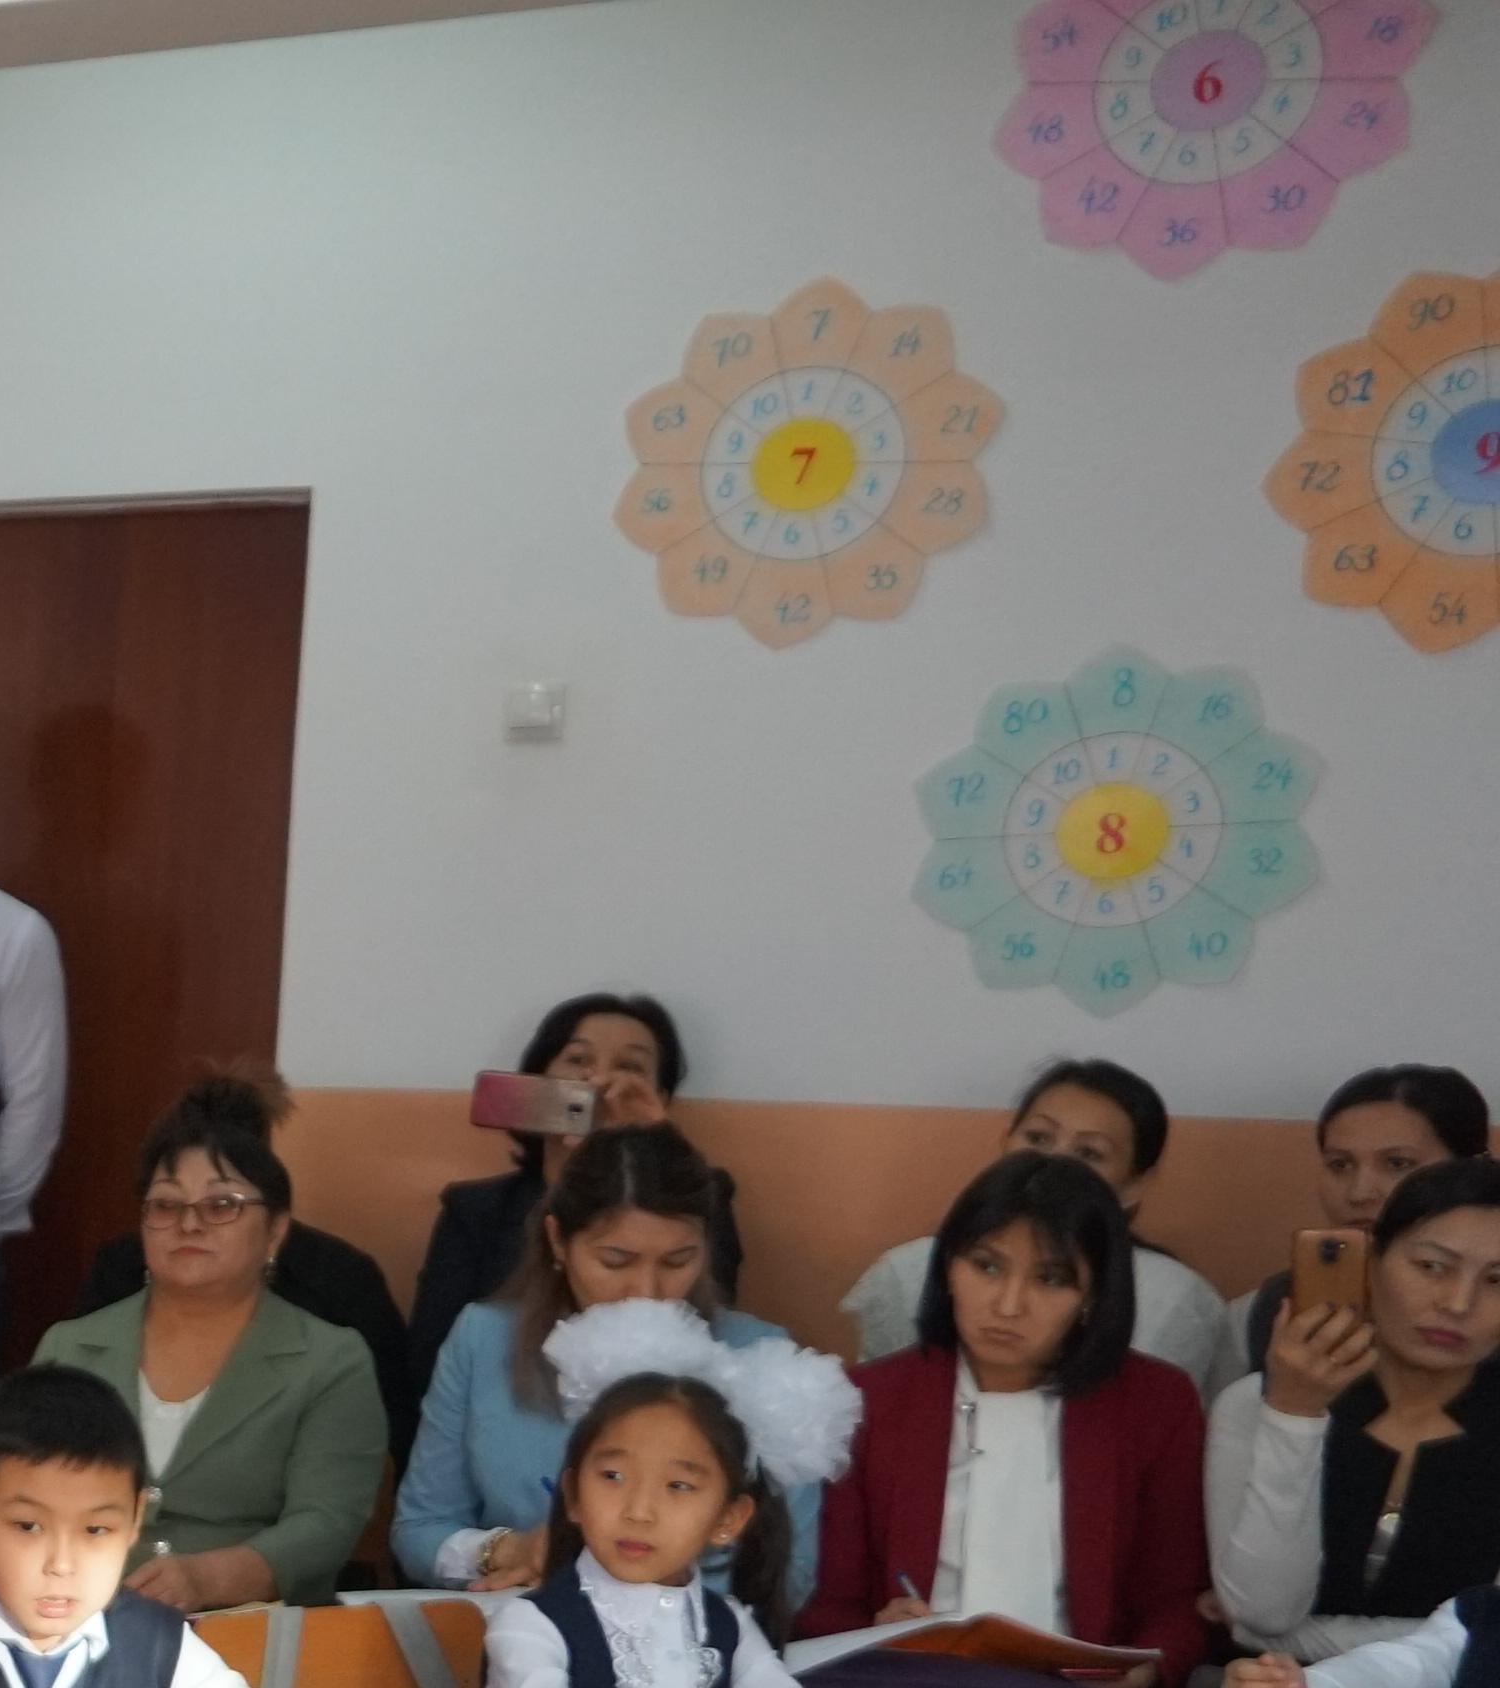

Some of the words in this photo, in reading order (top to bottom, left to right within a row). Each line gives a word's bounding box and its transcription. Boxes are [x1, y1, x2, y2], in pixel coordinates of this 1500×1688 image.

[1041, 19, 1079, 52] 54
[1366, 15, 1403, 44] 18
[1124, 47, 1144, 69] 9
[1286, 43, 1303, 67] 3
[1193, 60, 1224, 104] 6
[1109, 88, 1131, 121] 8
[1273, 89, 1291, 116] 4
[1343, 102, 1379, 130] 24
[1029, 114, 1064, 145] 48
[1138, 130, 1157, 155] 7
[1233, 128, 1252, 154] 5
[1179, 138, 1197, 166] 6
[1079, 176, 1120, 216] 42
[1265, 184, 1306, 215] 30
[1163, 217, 1198, 247] 36
[811, 308, 831, 342] 7
[1408, 293, 1455, 330] 90
[712, 332, 752, 368] 70
[888, 326, 921, 358] 14
[802, 380, 814, 402] 1
[1327, 368, 1376, 406] 81
[1440, 368, 1477, 395] 10
[752, 392, 779, 418] 10
[847, 391, 865, 415] 2
[1408, 402, 1428, 429] 9
[652, 405, 687, 432] 63
[940, 406, 979, 434] 21
[727, 430, 744, 454] 9
[874, 430, 886, 452] 3
[790, 446, 818, 486] 7
[1299, 460, 1342, 494] 72
[1386, 451, 1410, 482] 8
[717, 472, 735, 498] 8
[864, 475, 880, 497] 4
[922, 488, 965, 515] 28
[1411, 495, 1429, 523] 7
[743, 511, 759, 535] 7
[784, 523, 800, 545] 6
[833, 510, 850, 534] 5
[1454, 513, 1473, 541] 6
[693, 555, 728, 583] 49
[1333, 544, 1377, 573] 63
[865, 564, 898, 591] 35
[775, 593, 811, 624] 42
[1427, 591, 1467, 626] 54
[1112, 667, 1136, 707] 8
[1003, 698, 1050, 735] 80
[1198, 693, 1233, 723] 16
[1052, 758, 1082, 785] 10
[1107, 746, 1118, 770] 1
[1150, 752, 1170, 775] 2
[947, 771, 987, 806] 72
[1251, 758, 1293, 791] 24
[1026, 799, 1045, 826] 9
[1185, 790, 1201, 813] 3
[1096, 812, 1128, 854] 8
[1023, 842, 1042, 869] 8
[1180, 838, 1194, 859] 4
[1248, 847, 1283, 877] 32
[937, 859, 975, 890] 64
[1053, 880, 1071, 905] 7
[1148, 876, 1167, 902] 5
[1098, 891, 1115, 916] 6
[1001, 932, 1037, 961] 56
[1187, 931, 1228, 962] 40
[1092, 961, 1131, 990] 48
